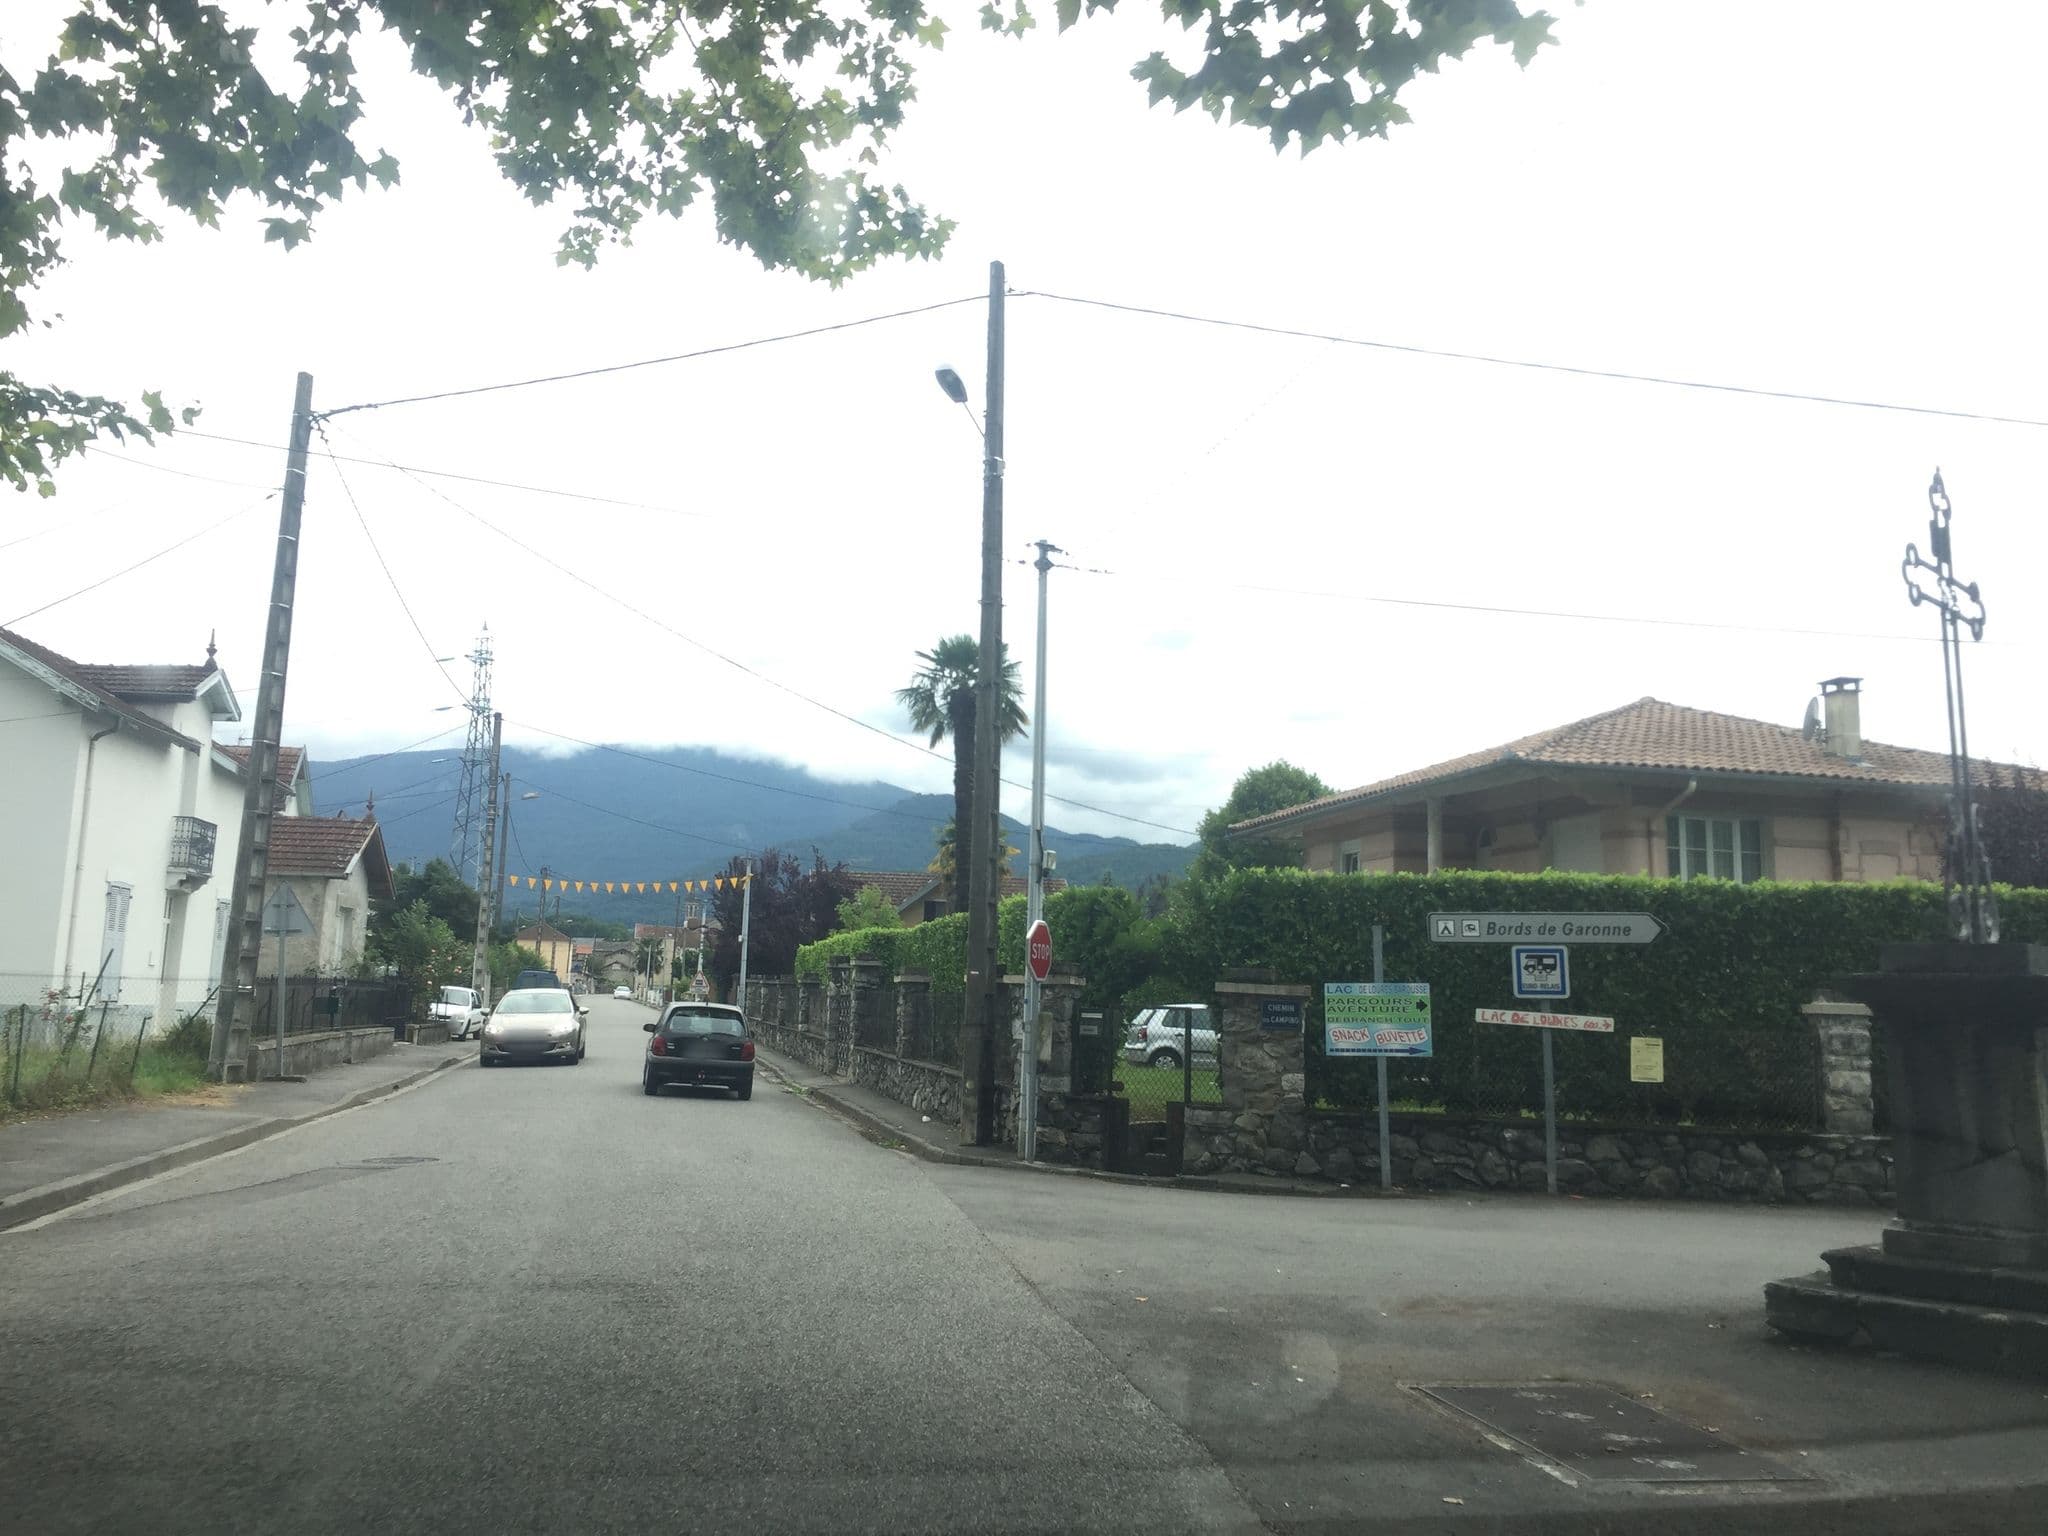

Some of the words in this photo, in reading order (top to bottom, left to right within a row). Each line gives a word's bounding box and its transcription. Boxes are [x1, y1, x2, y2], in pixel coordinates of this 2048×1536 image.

[1487, 921, 1532, 937] Bords
[1538, 921, 1557, 937] de
[1562, 921, 1632, 937] Garonne
[1031, 942, 1050, 961] STOP
[1326, 985, 1353, 994] LAC
[1267, 1004, 1295, 1012] CHEMIN
[1327, 998, 1413, 1006] PARCOURS
[1481, 1010, 1506, 1022] LAC
[1511, 1012, 1530, 1024] DE
[1331, 1028, 1369, 1042] SNACK
[1375, 1030, 1426, 1044] BUVETTE
